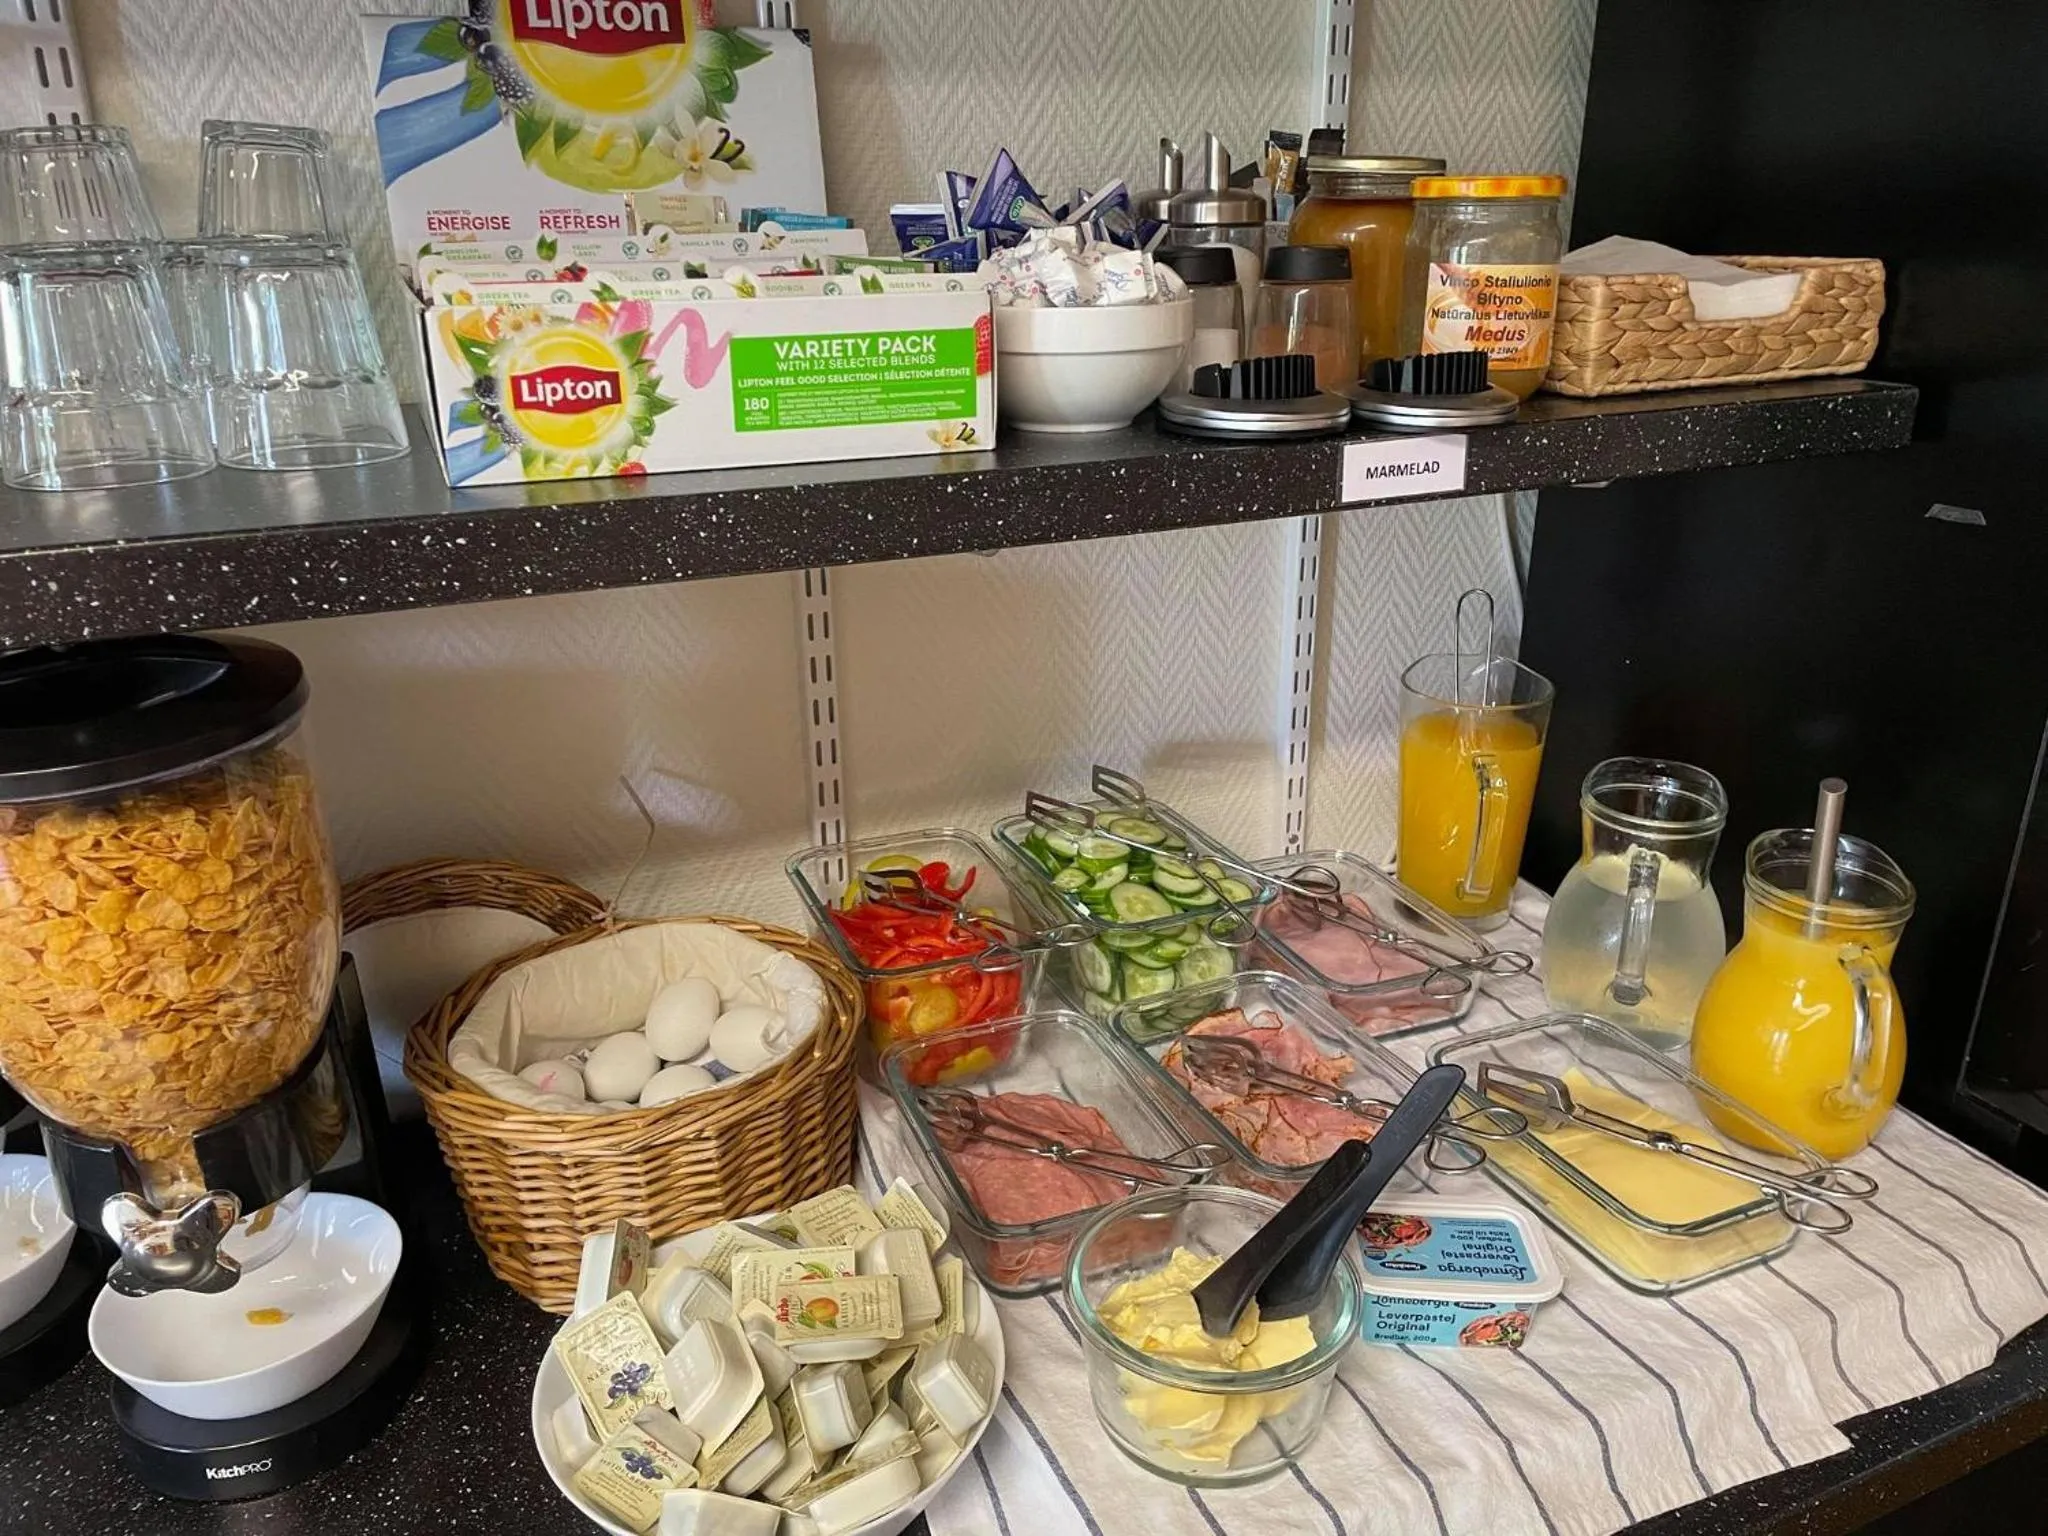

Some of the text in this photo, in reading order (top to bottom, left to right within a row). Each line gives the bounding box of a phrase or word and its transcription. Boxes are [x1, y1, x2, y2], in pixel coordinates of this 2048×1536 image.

[525, 0, 670, 39] Lipton
[427, 216, 511, 231] ENERGISE
[540, 215, 620, 229] REFRESH
[1465, 325, 1526, 342] Medus
[774, 335, 937, 359] VARIETY PACK
[776, 353, 936, 372] WITH 12 SELECTED BLENDS
[738, 377, 774, 388] LIPTON
[775, 376, 796, 386] FEEL
[797, 374, 826, 385] GOOD
[828, 372, 878, 383] SELECTION
[520, 377, 612, 407] Lipton
[743, 397, 770, 411] 180
[1366, 461, 1440, 480] MARMELAD
[1441, 1250, 1519, 1263] Leverpastej
[1462, 1243, 1516, 1254] Original
[1436, 1262, 1527, 1281] Lönneberga
[1378, 1310, 1457, 1323] Leverpastej
[1376, 1319, 1430, 1332] Original
[206, 1460, 271, 1479] KitchPRO
